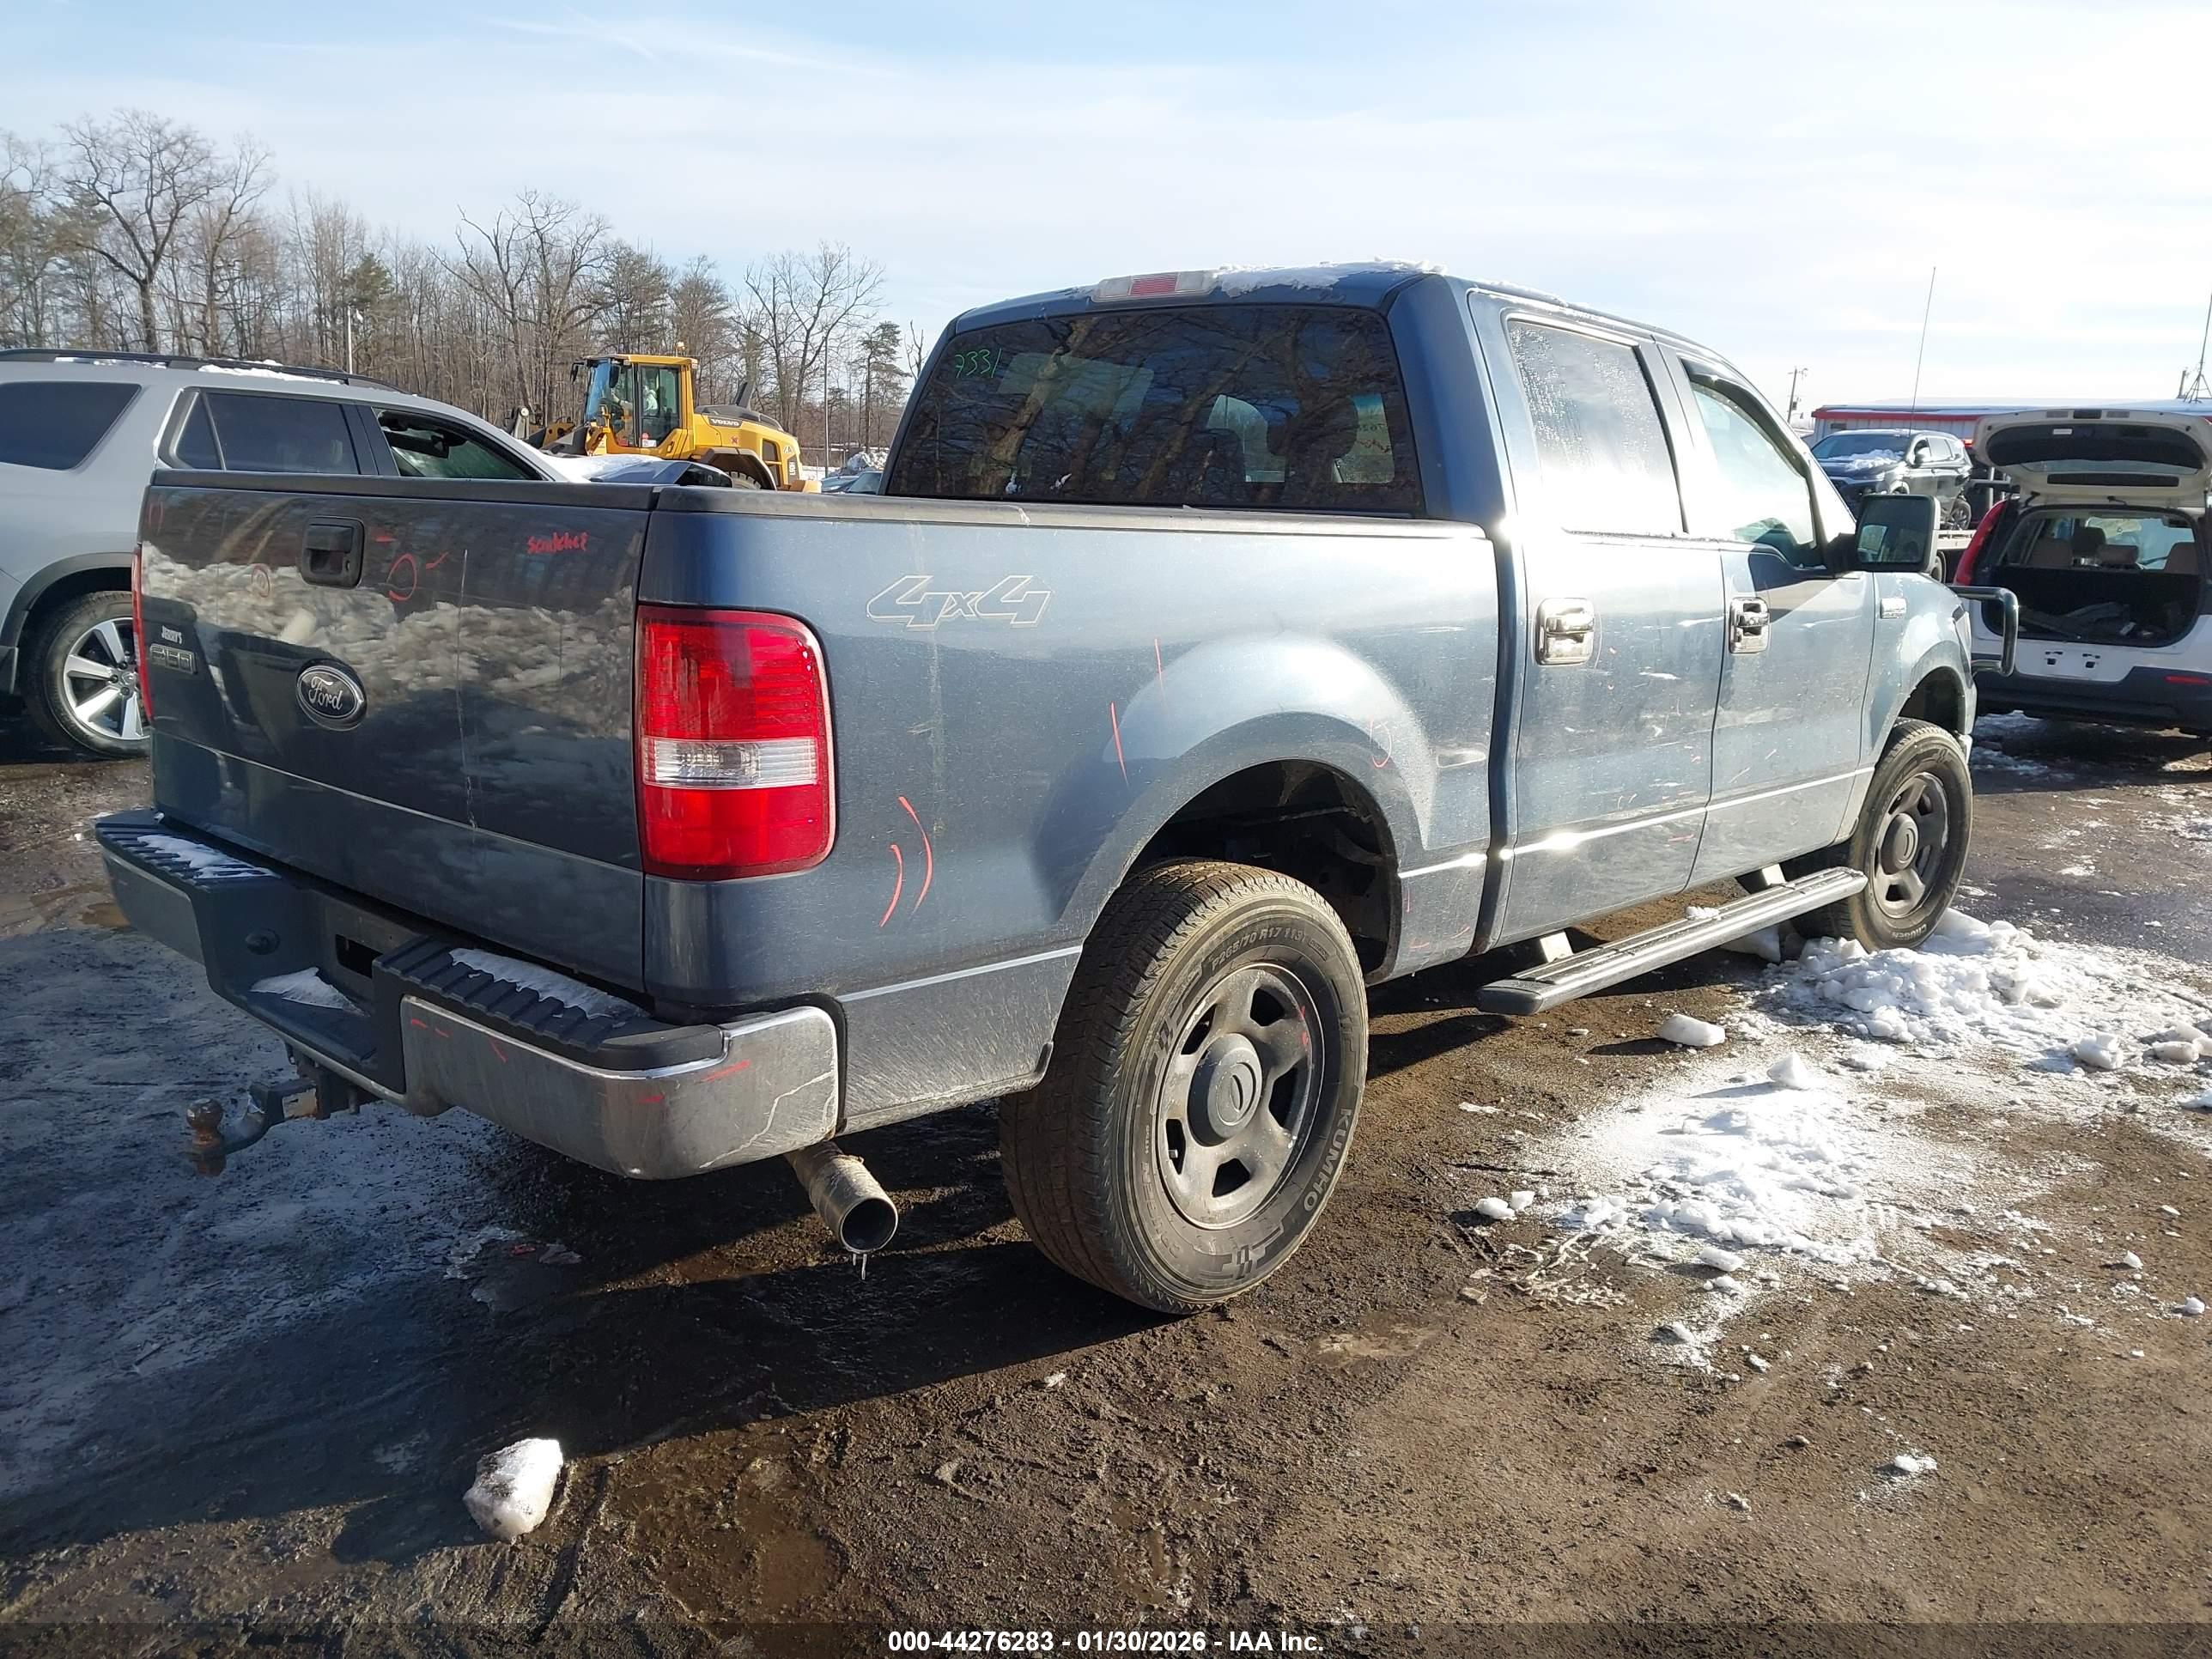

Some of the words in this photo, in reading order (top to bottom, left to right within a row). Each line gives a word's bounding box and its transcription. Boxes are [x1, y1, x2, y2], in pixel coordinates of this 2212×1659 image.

[954, 347, 1002, 379] 7331
[710, 417, 739, 427] VOLVO
[866, 574, 1053, 631] 4x4
[308, 676, 343, 711] Ford
[1258, 927, 1283, 941] R17
[1304, 1108, 1352, 1212] KUMHO
